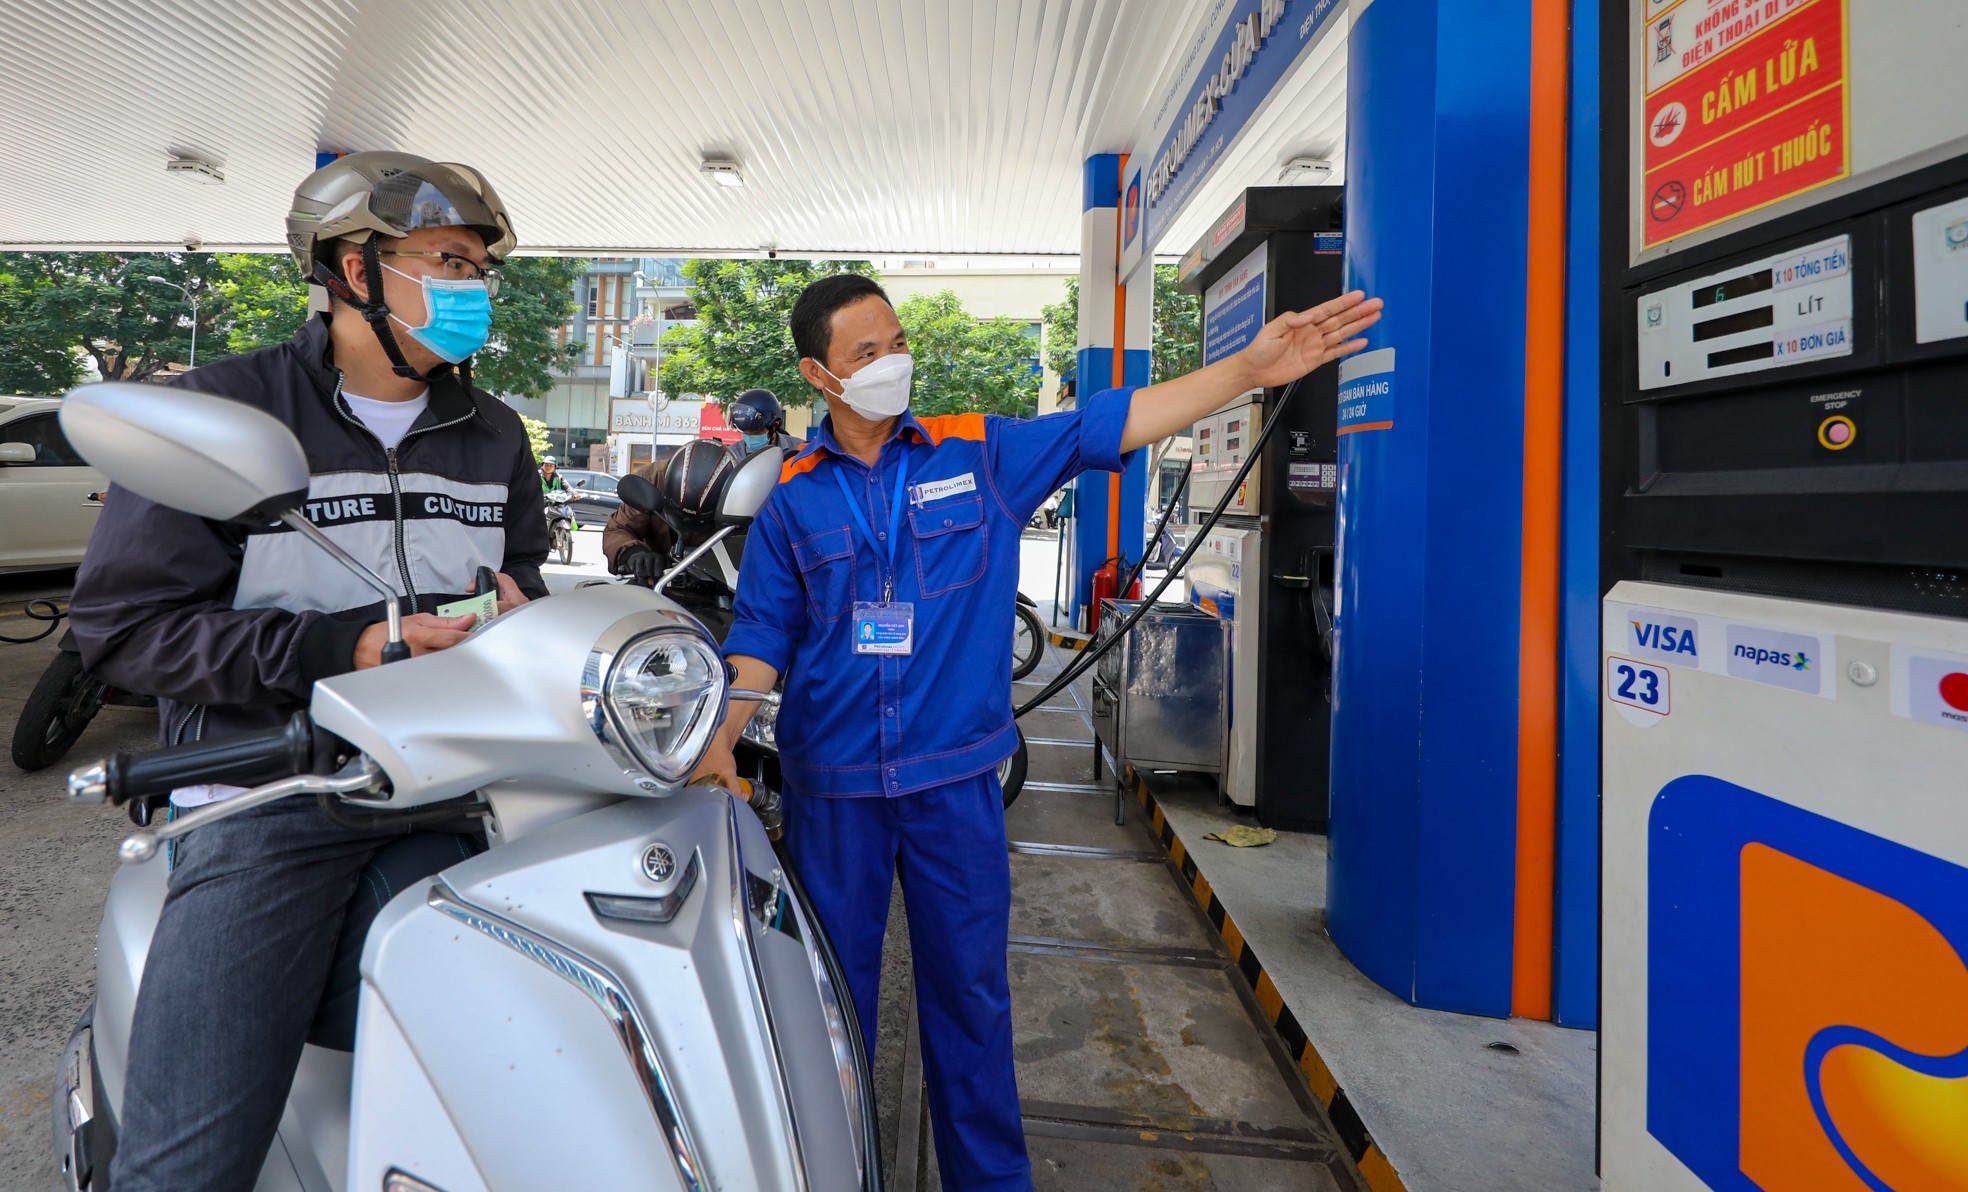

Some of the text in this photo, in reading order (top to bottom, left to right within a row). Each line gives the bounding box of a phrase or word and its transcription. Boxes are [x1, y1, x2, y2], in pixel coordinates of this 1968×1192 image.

[1695, 1, 1739, 39] KHÔNG
[1682, 38, 1713, 68] ĐIỆN
[1717, 9, 1759, 47] THOẠI
[1701, 37, 1819, 125] CẤM LỬA
[1693, 119, 1832, 207] CẤM HÚT THUỐC
[1775, 250, 1846, 285] X 10 TỔNG TIỀN
[1715, 287, 1725, 303] 6
[1798, 295, 1824, 316] LÍT
[1777, 327, 1846, 355] X 10 ĐƠN GIÁ
[1353, 383, 1365, 400] BÁN
[1366, 380, 1389, 398] HÀNG
[1810, 389, 1862, 410] EMERGENCY STOP
[615, 411, 699, 429] BÁNH MÌ 362
[924, 479, 973, 495] PETROLIMEX
[1232, 563, 1240, 579] 22
[1630, 621, 1791, 666] VISA napas
[1616, 665, 1659, 706] 23
[1941, 711, 1968, 722] mas
